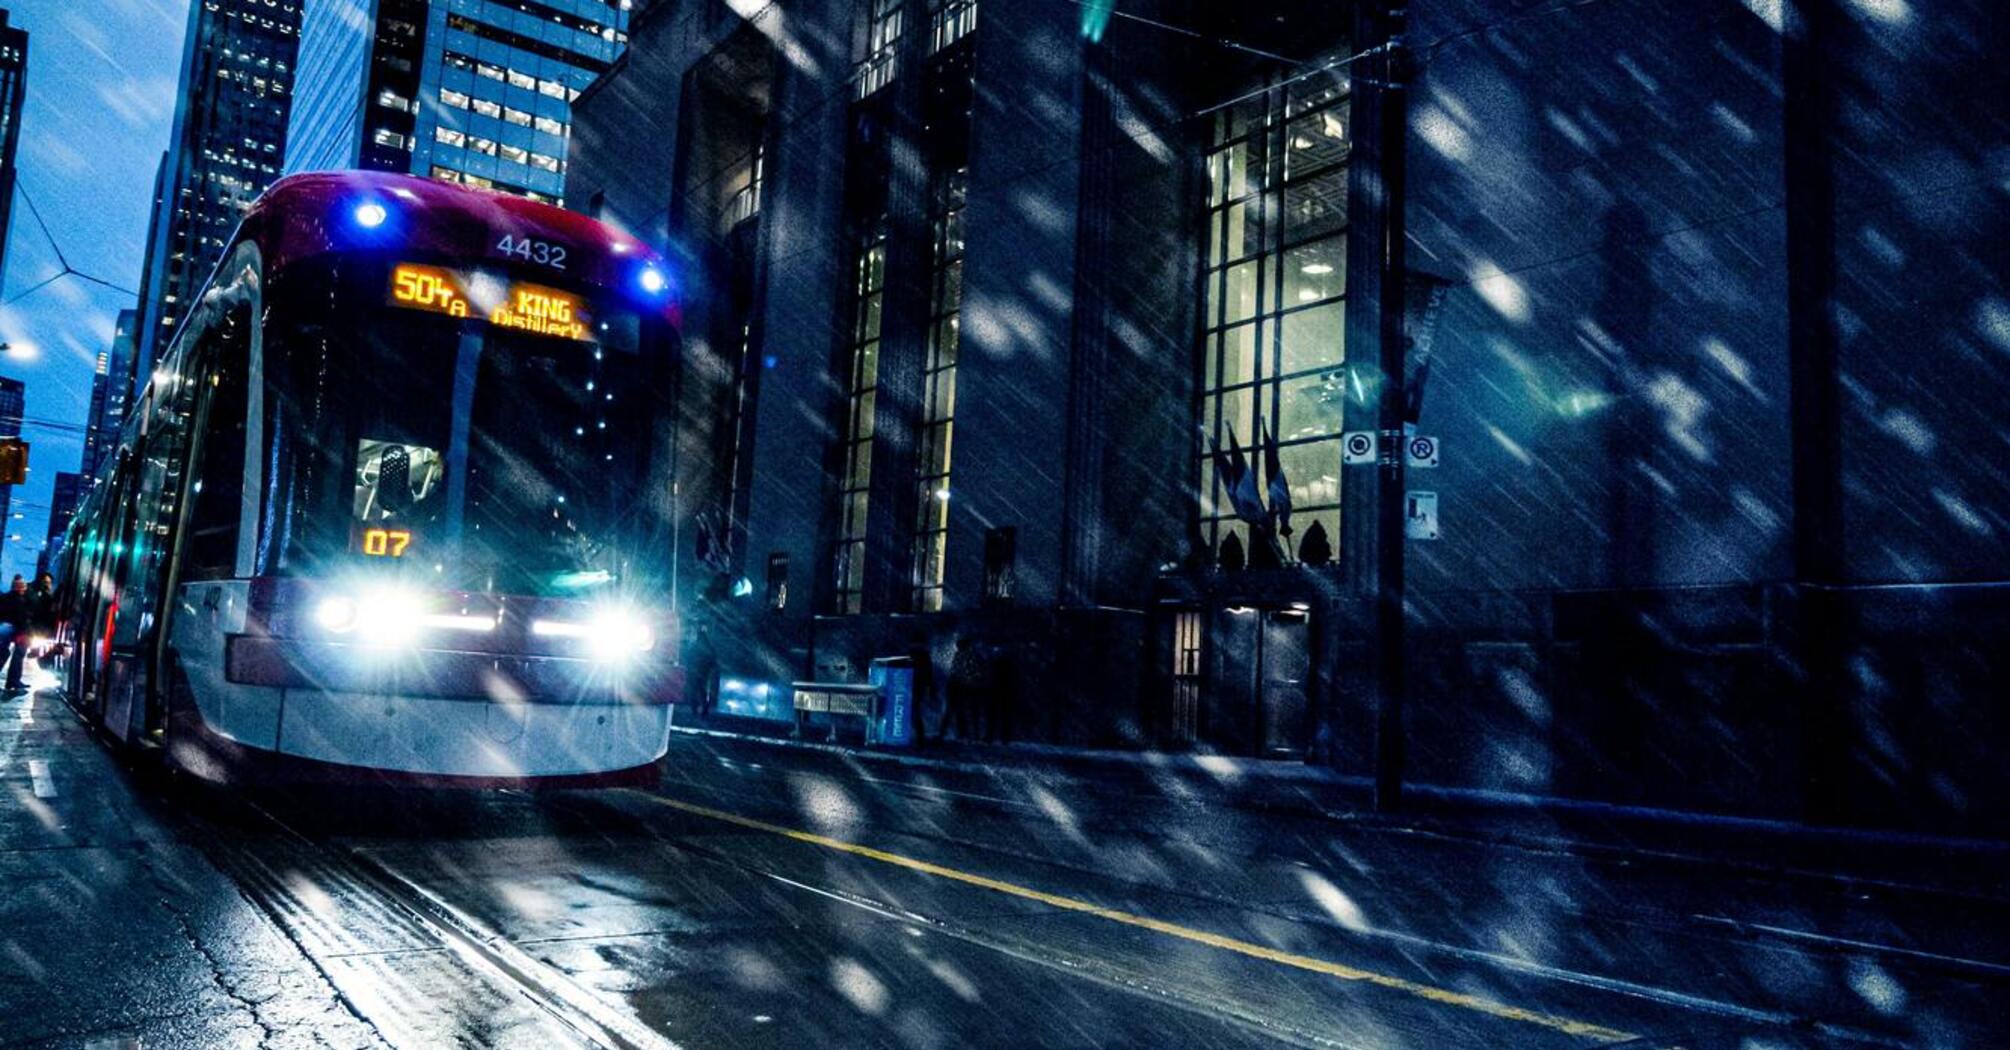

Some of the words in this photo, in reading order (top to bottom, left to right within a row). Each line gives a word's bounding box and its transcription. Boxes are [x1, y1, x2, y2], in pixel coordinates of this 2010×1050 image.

[496, 234, 567, 270] 4432
[518, 290, 570, 323] KING
[365, 529, 411, 557] 07
